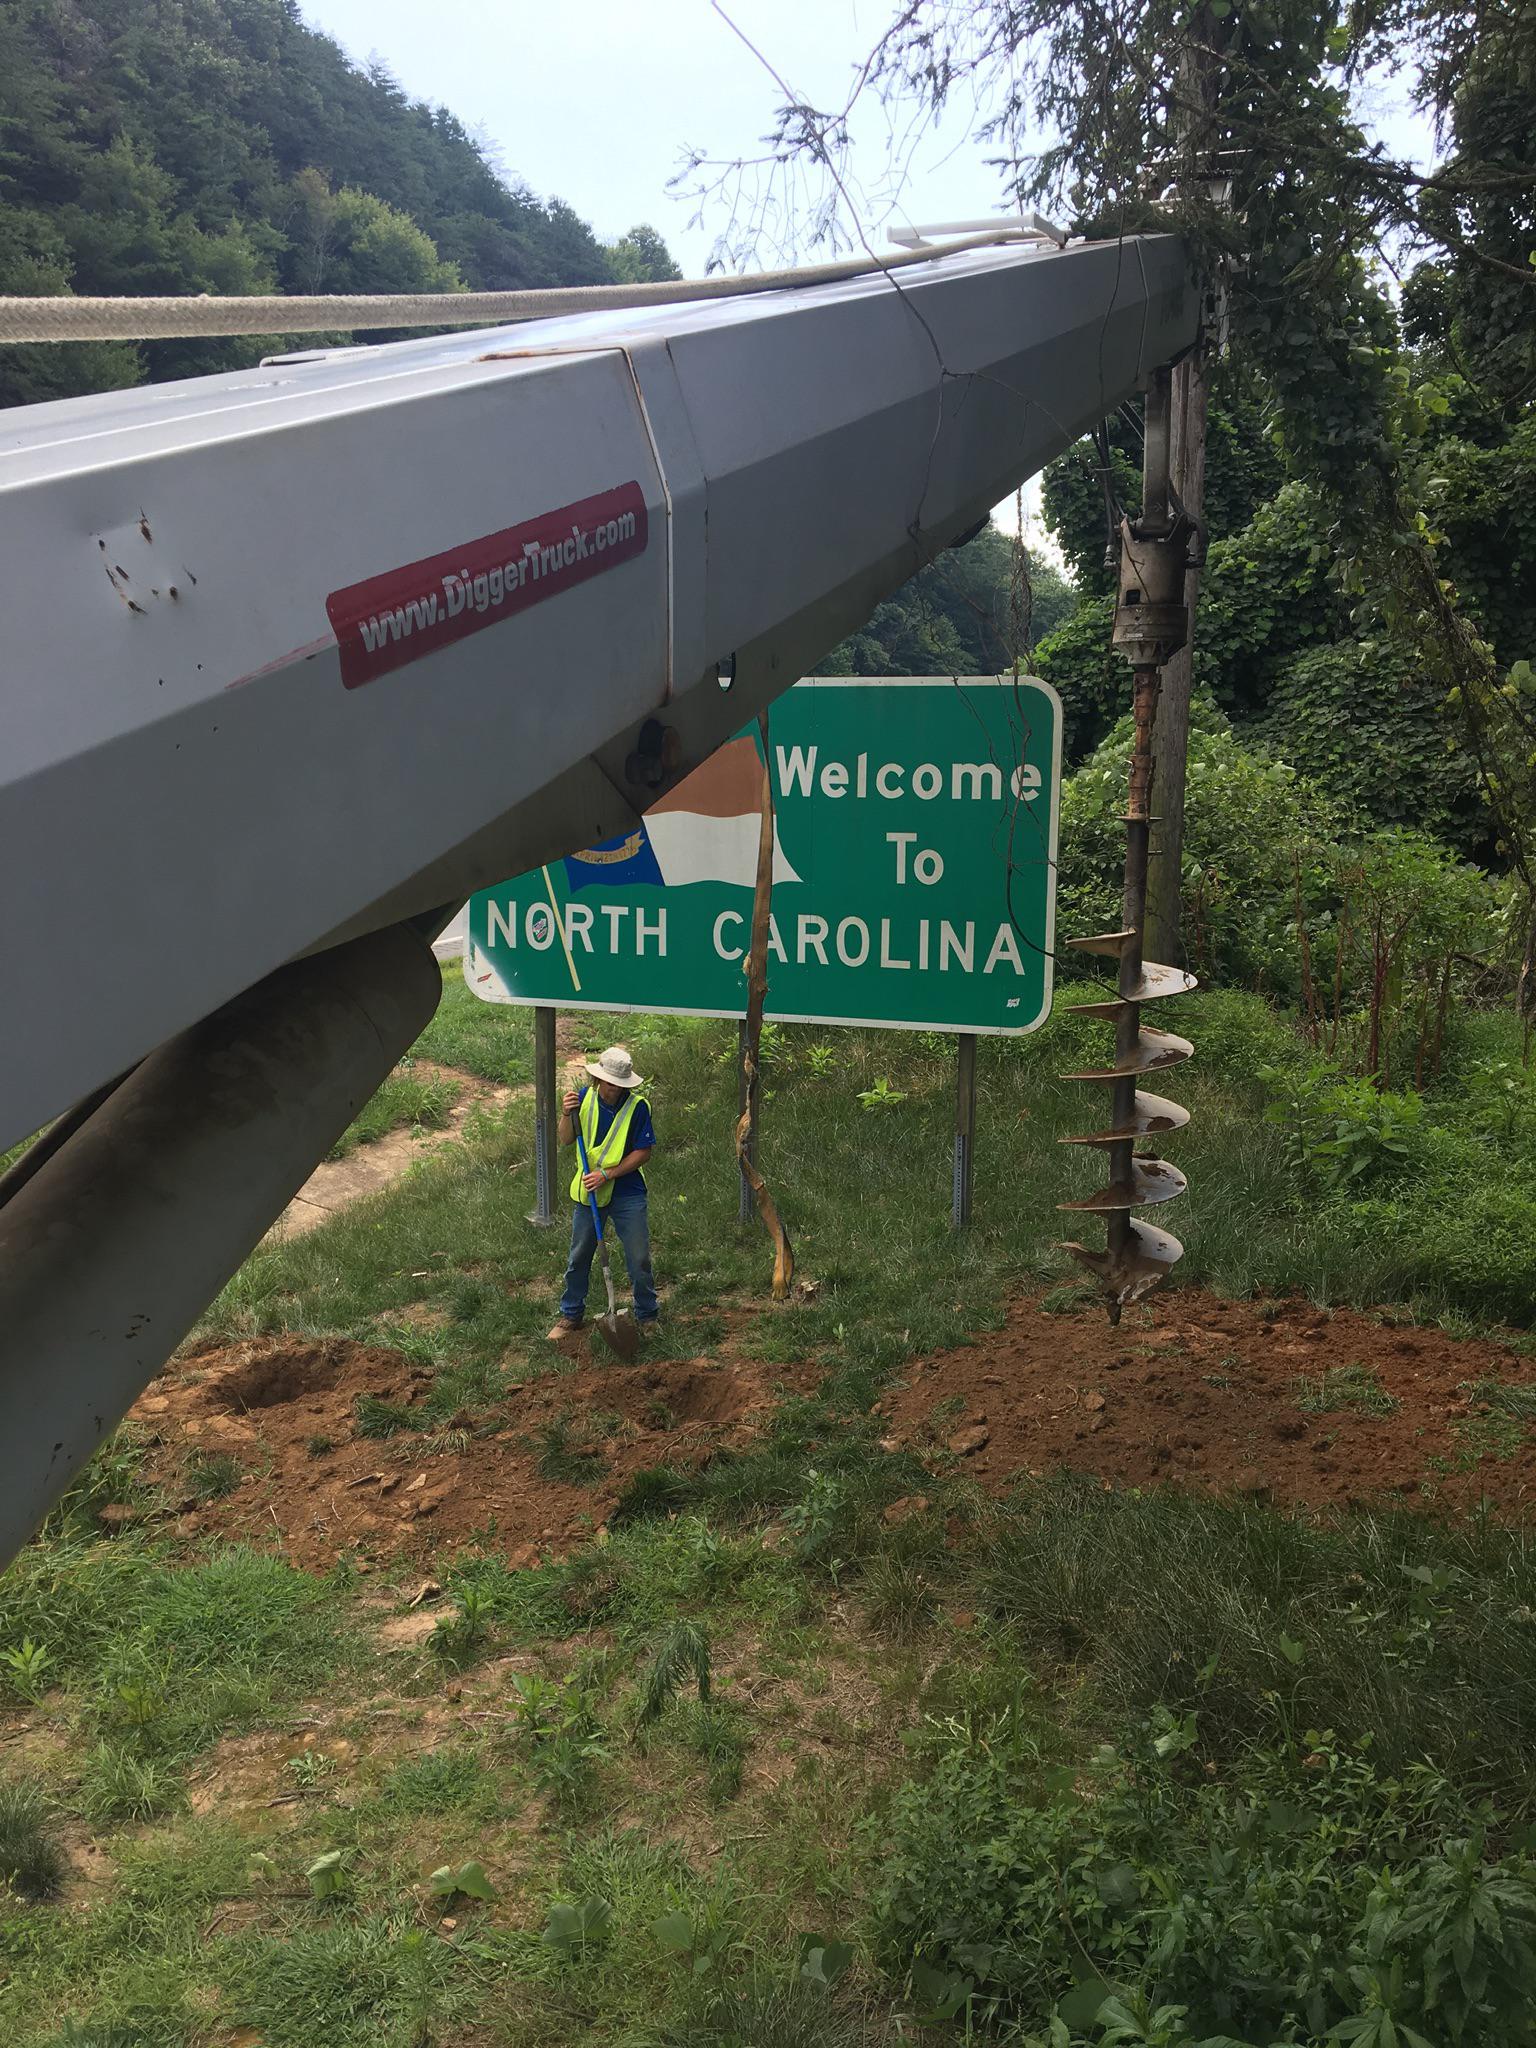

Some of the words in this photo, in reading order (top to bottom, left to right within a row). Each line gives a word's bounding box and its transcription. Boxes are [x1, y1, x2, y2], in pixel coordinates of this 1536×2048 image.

[358, 511, 636, 653] www.DiggerTruck.com
[775, 745, 1042, 801] Welcome
[886, 832, 944, 885] To
[487, 900, 667, 957] NORTH
[713, 910, 1025, 976] CAROLINA
